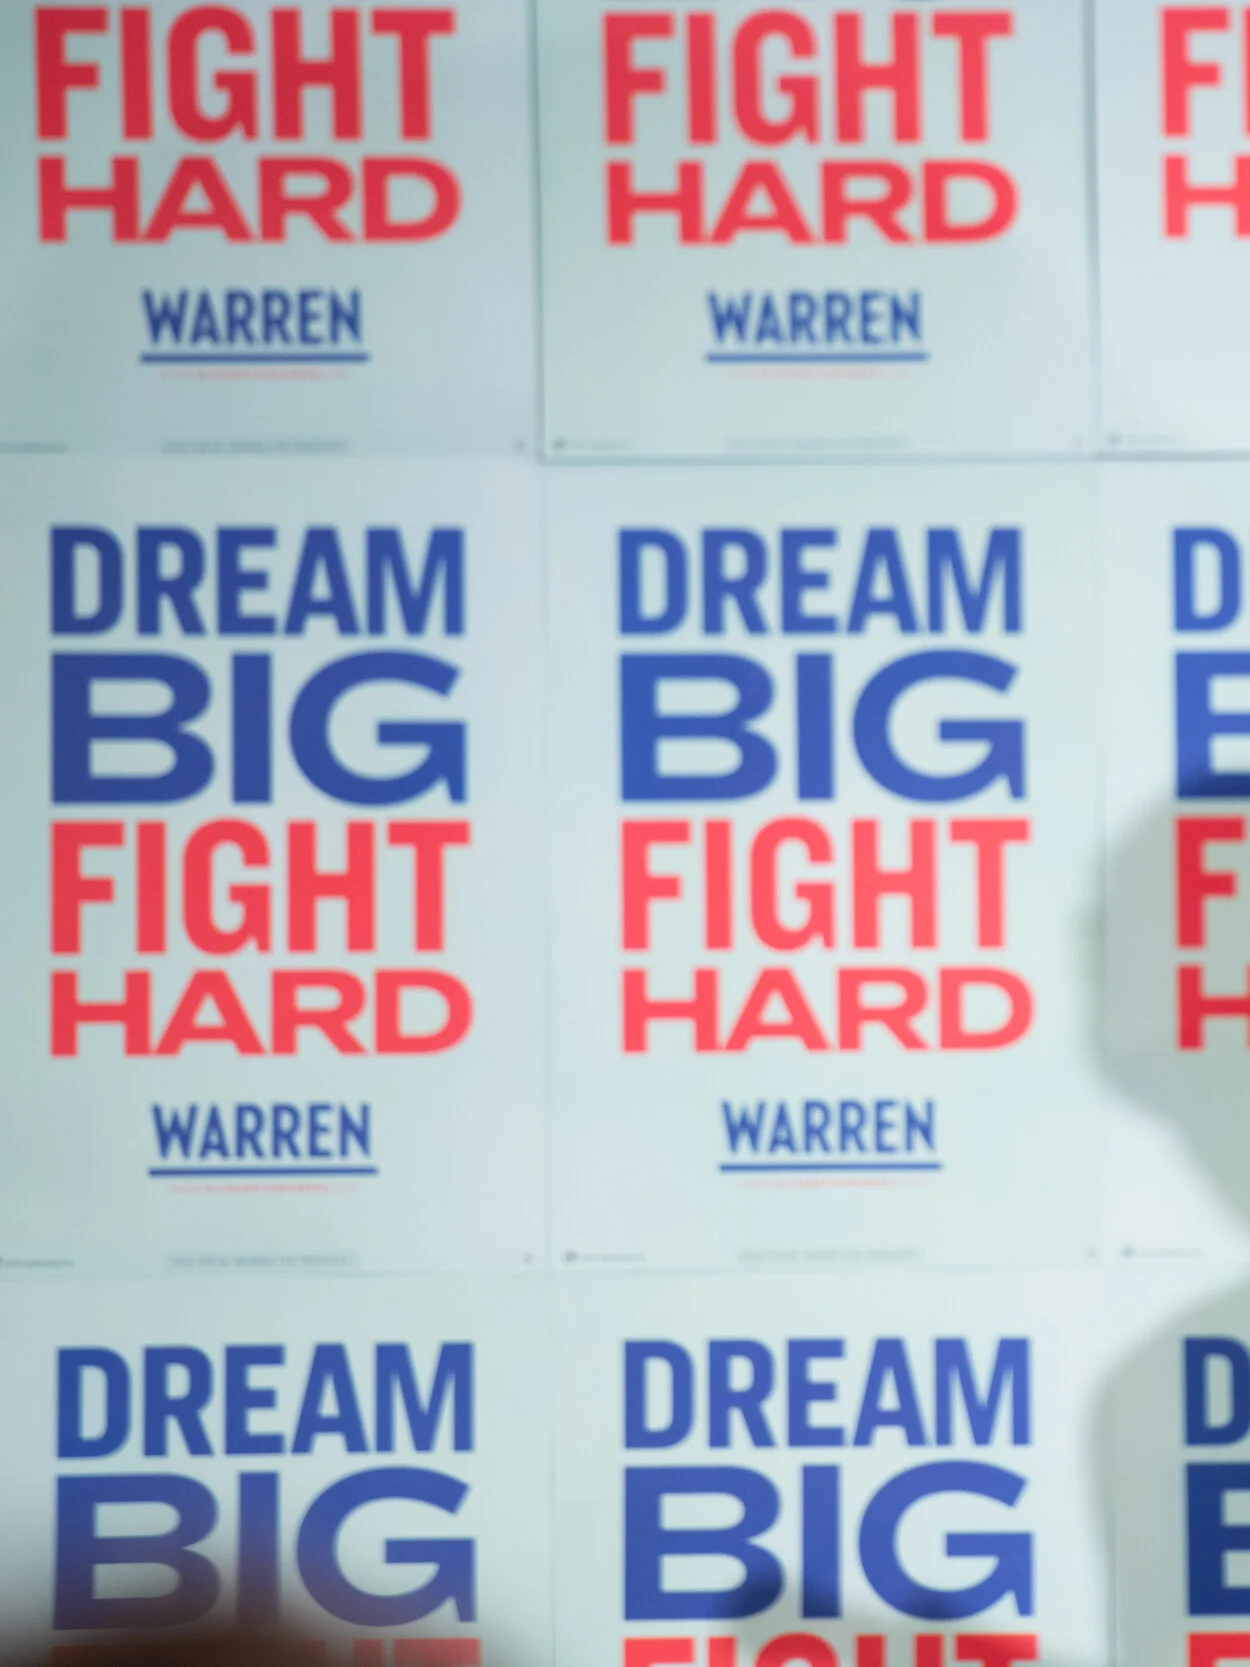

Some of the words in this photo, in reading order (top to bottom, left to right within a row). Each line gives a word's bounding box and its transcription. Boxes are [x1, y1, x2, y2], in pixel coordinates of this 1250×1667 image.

[34, 5, 456, 142] FIGHT
[602, 9, 1014, 147] FIGHT
[37, 155, 462, 243] HARD
[605, 159, 1019, 246] HARD
[141, 288, 363, 346] WARREN
[706, 291, 922, 345] WARREN
[48, 525, 464, 637] DREAM
[617, 527, 1022, 636] DREAM
[49, 650, 466, 806] BIG
[619, 650, 1024, 802] BIG
[50, 818, 472, 956] FIGHT
[620, 816, 1031, 953] FIGHT
[50, 968, 474, 1058] HARD
[621, 965, 1035, 1055] HARD
[152, 1103, 371, 1159] WARREN
[721, 1100, 934, 1154] WARREN
[56, 1342, 473, 1460] DREAM
[623, 1338, 1031, 1449] DREAM
[54, 1466, 477, 1630] BIG
[624, 1461, 1034, 1621] BIG
